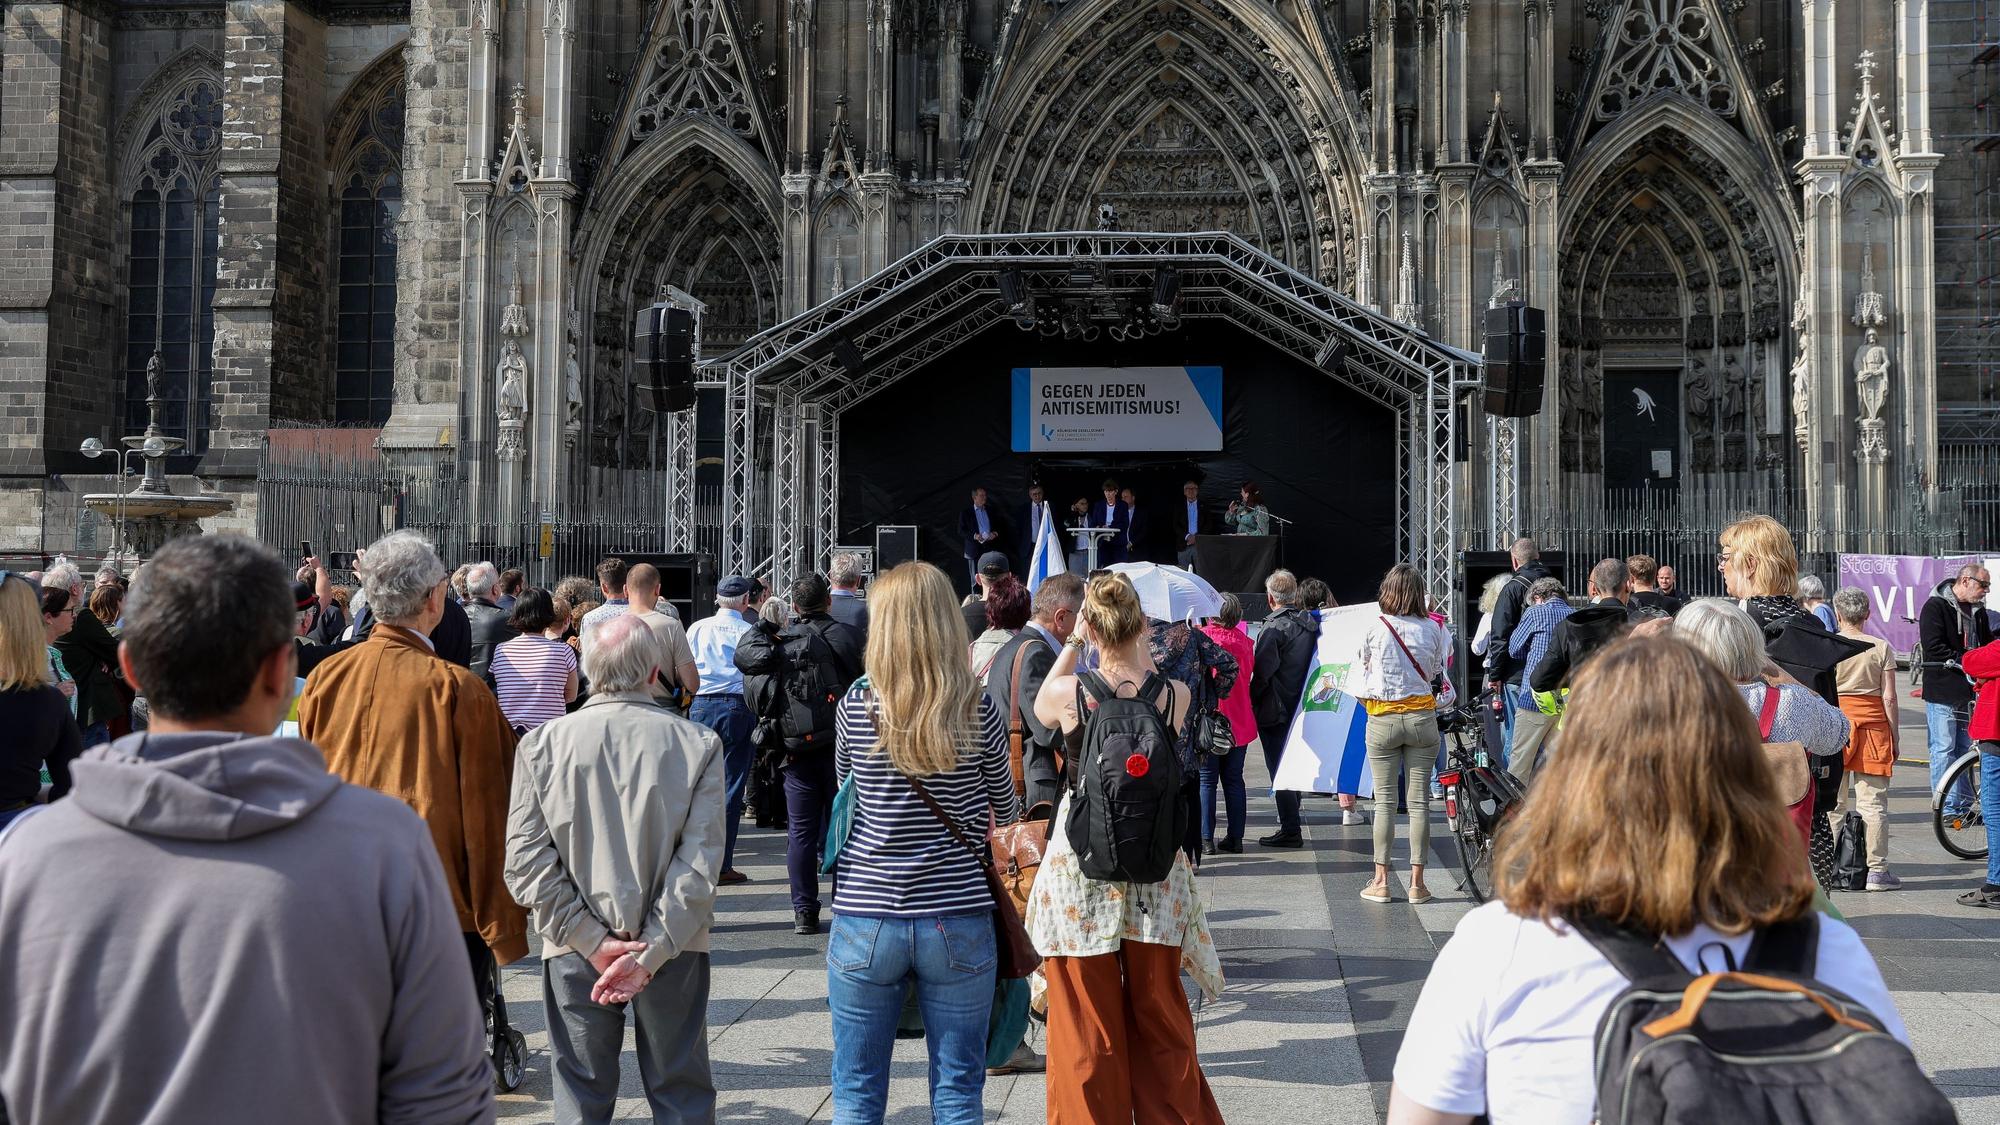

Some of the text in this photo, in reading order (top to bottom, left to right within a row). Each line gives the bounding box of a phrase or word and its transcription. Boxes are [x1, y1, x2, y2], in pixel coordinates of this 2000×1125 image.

[1042, 383, 1146, 399] GEGEN JEDEN
[1041, 400, 1180, 415] ANTISEMITISMUS!
[1841, 555, 1898, 575] Stadt
